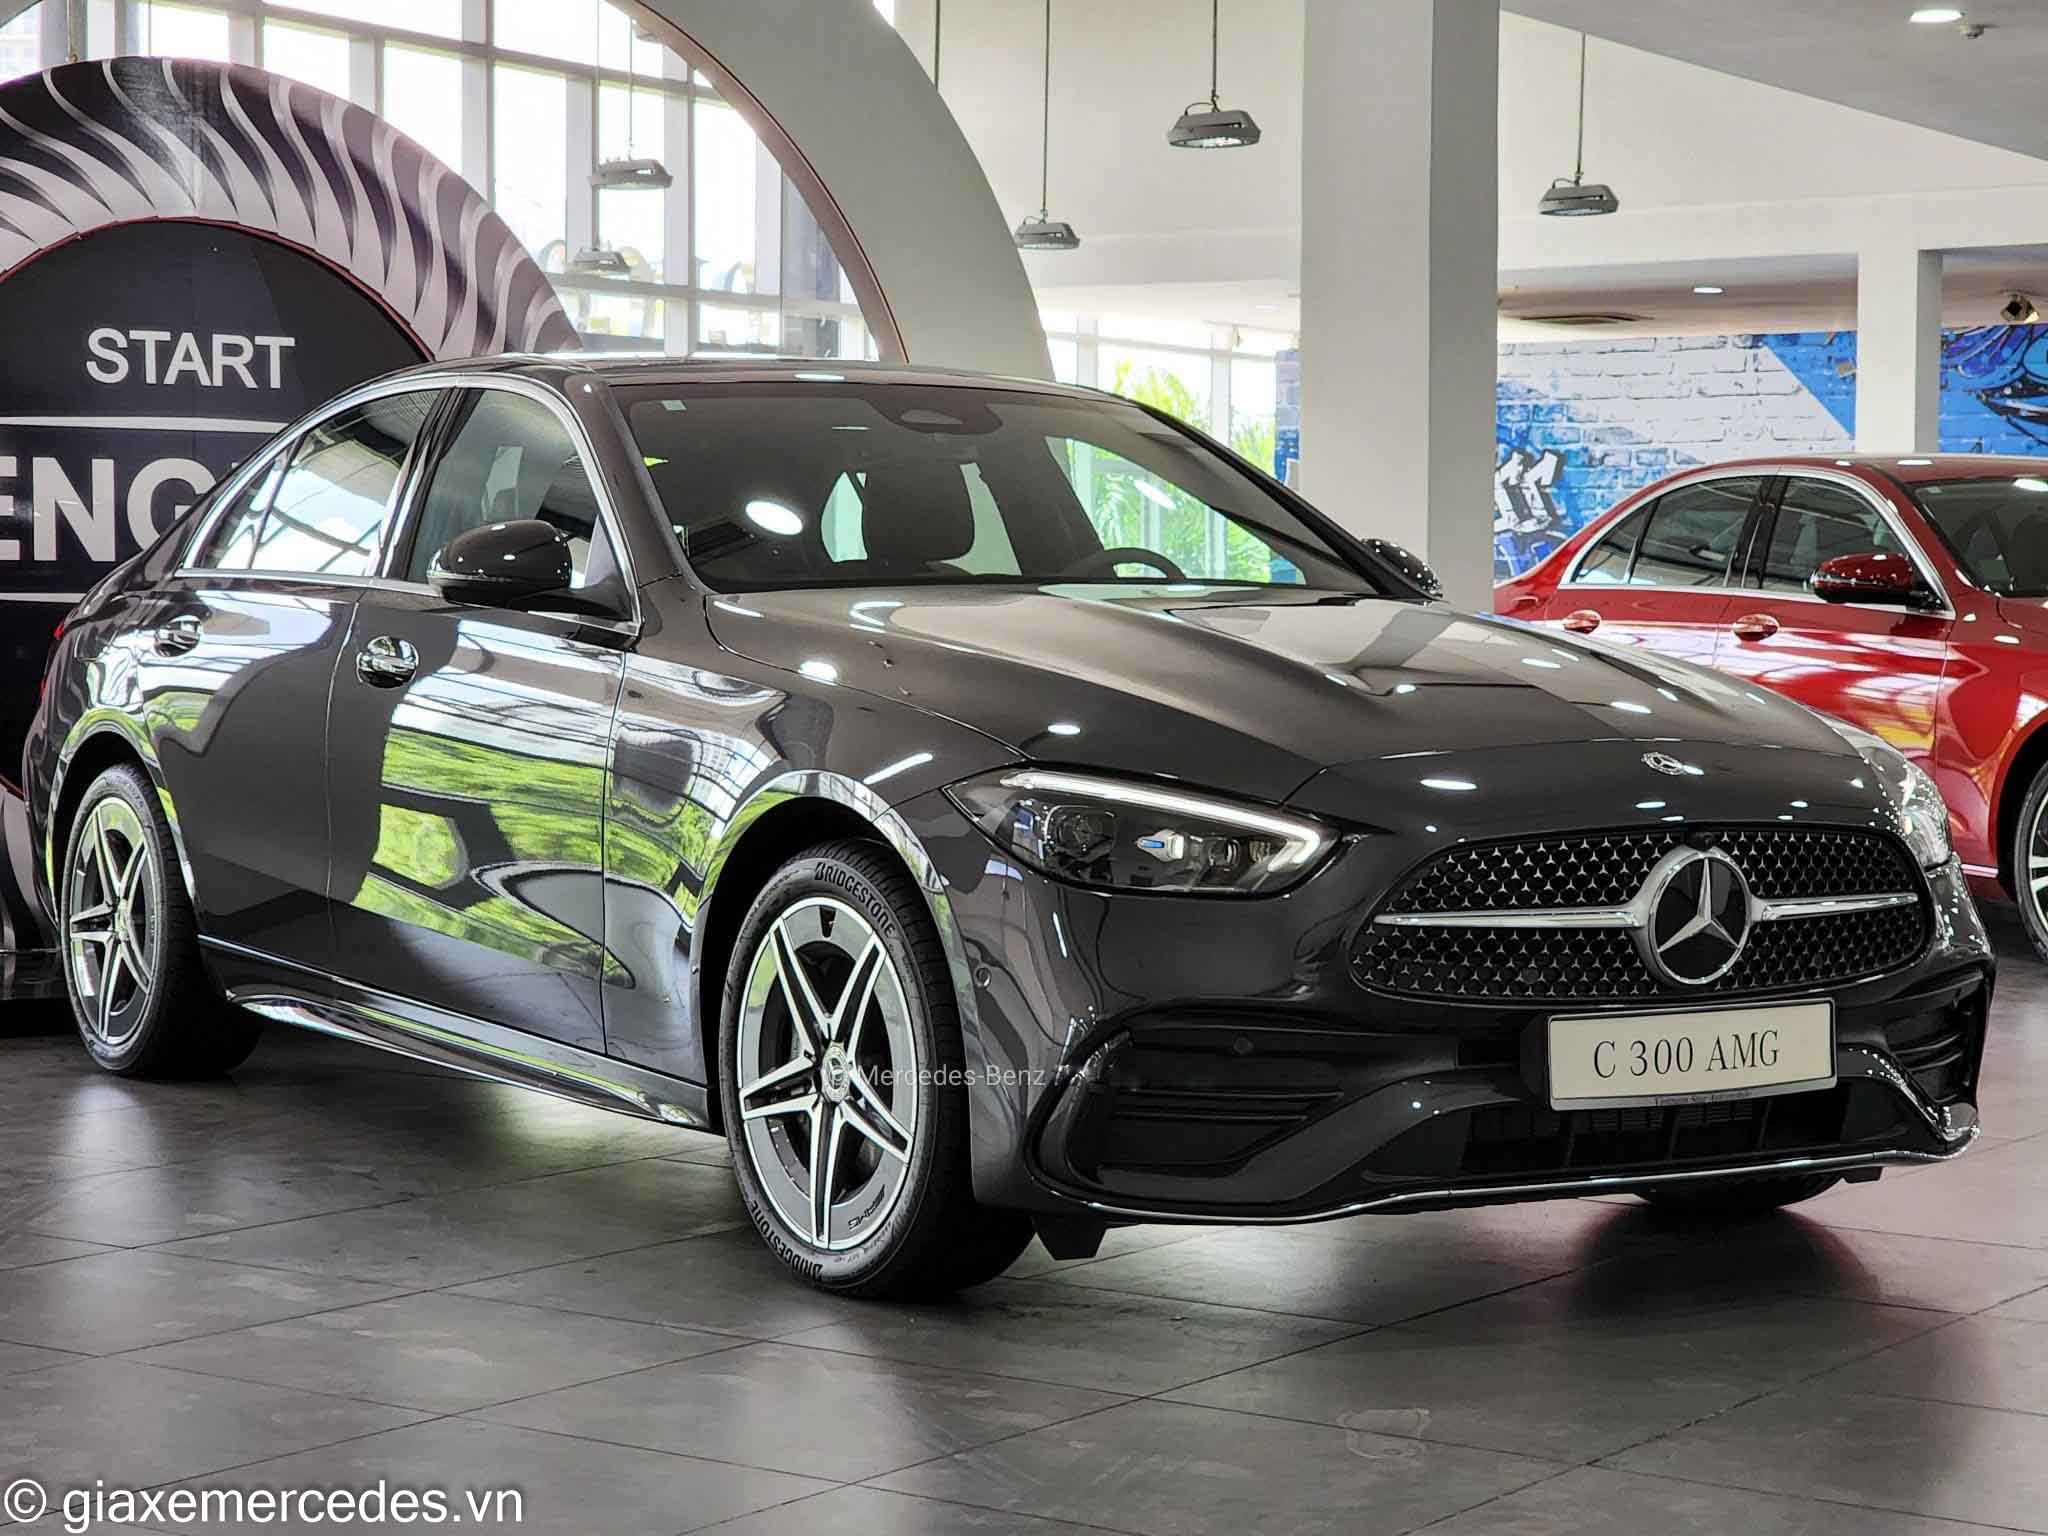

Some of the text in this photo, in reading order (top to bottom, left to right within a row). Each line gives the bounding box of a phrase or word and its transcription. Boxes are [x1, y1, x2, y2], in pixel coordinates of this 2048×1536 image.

[86, 329, 295, 389] START
[0, 456, 238, 561] ENG
[814, 861, 896, 938] BRIDGESTONE
[1593, 1030, 1779, 1078] C 300 AMG
[752, 1200, 823, 1282] BRIDGESTONE
